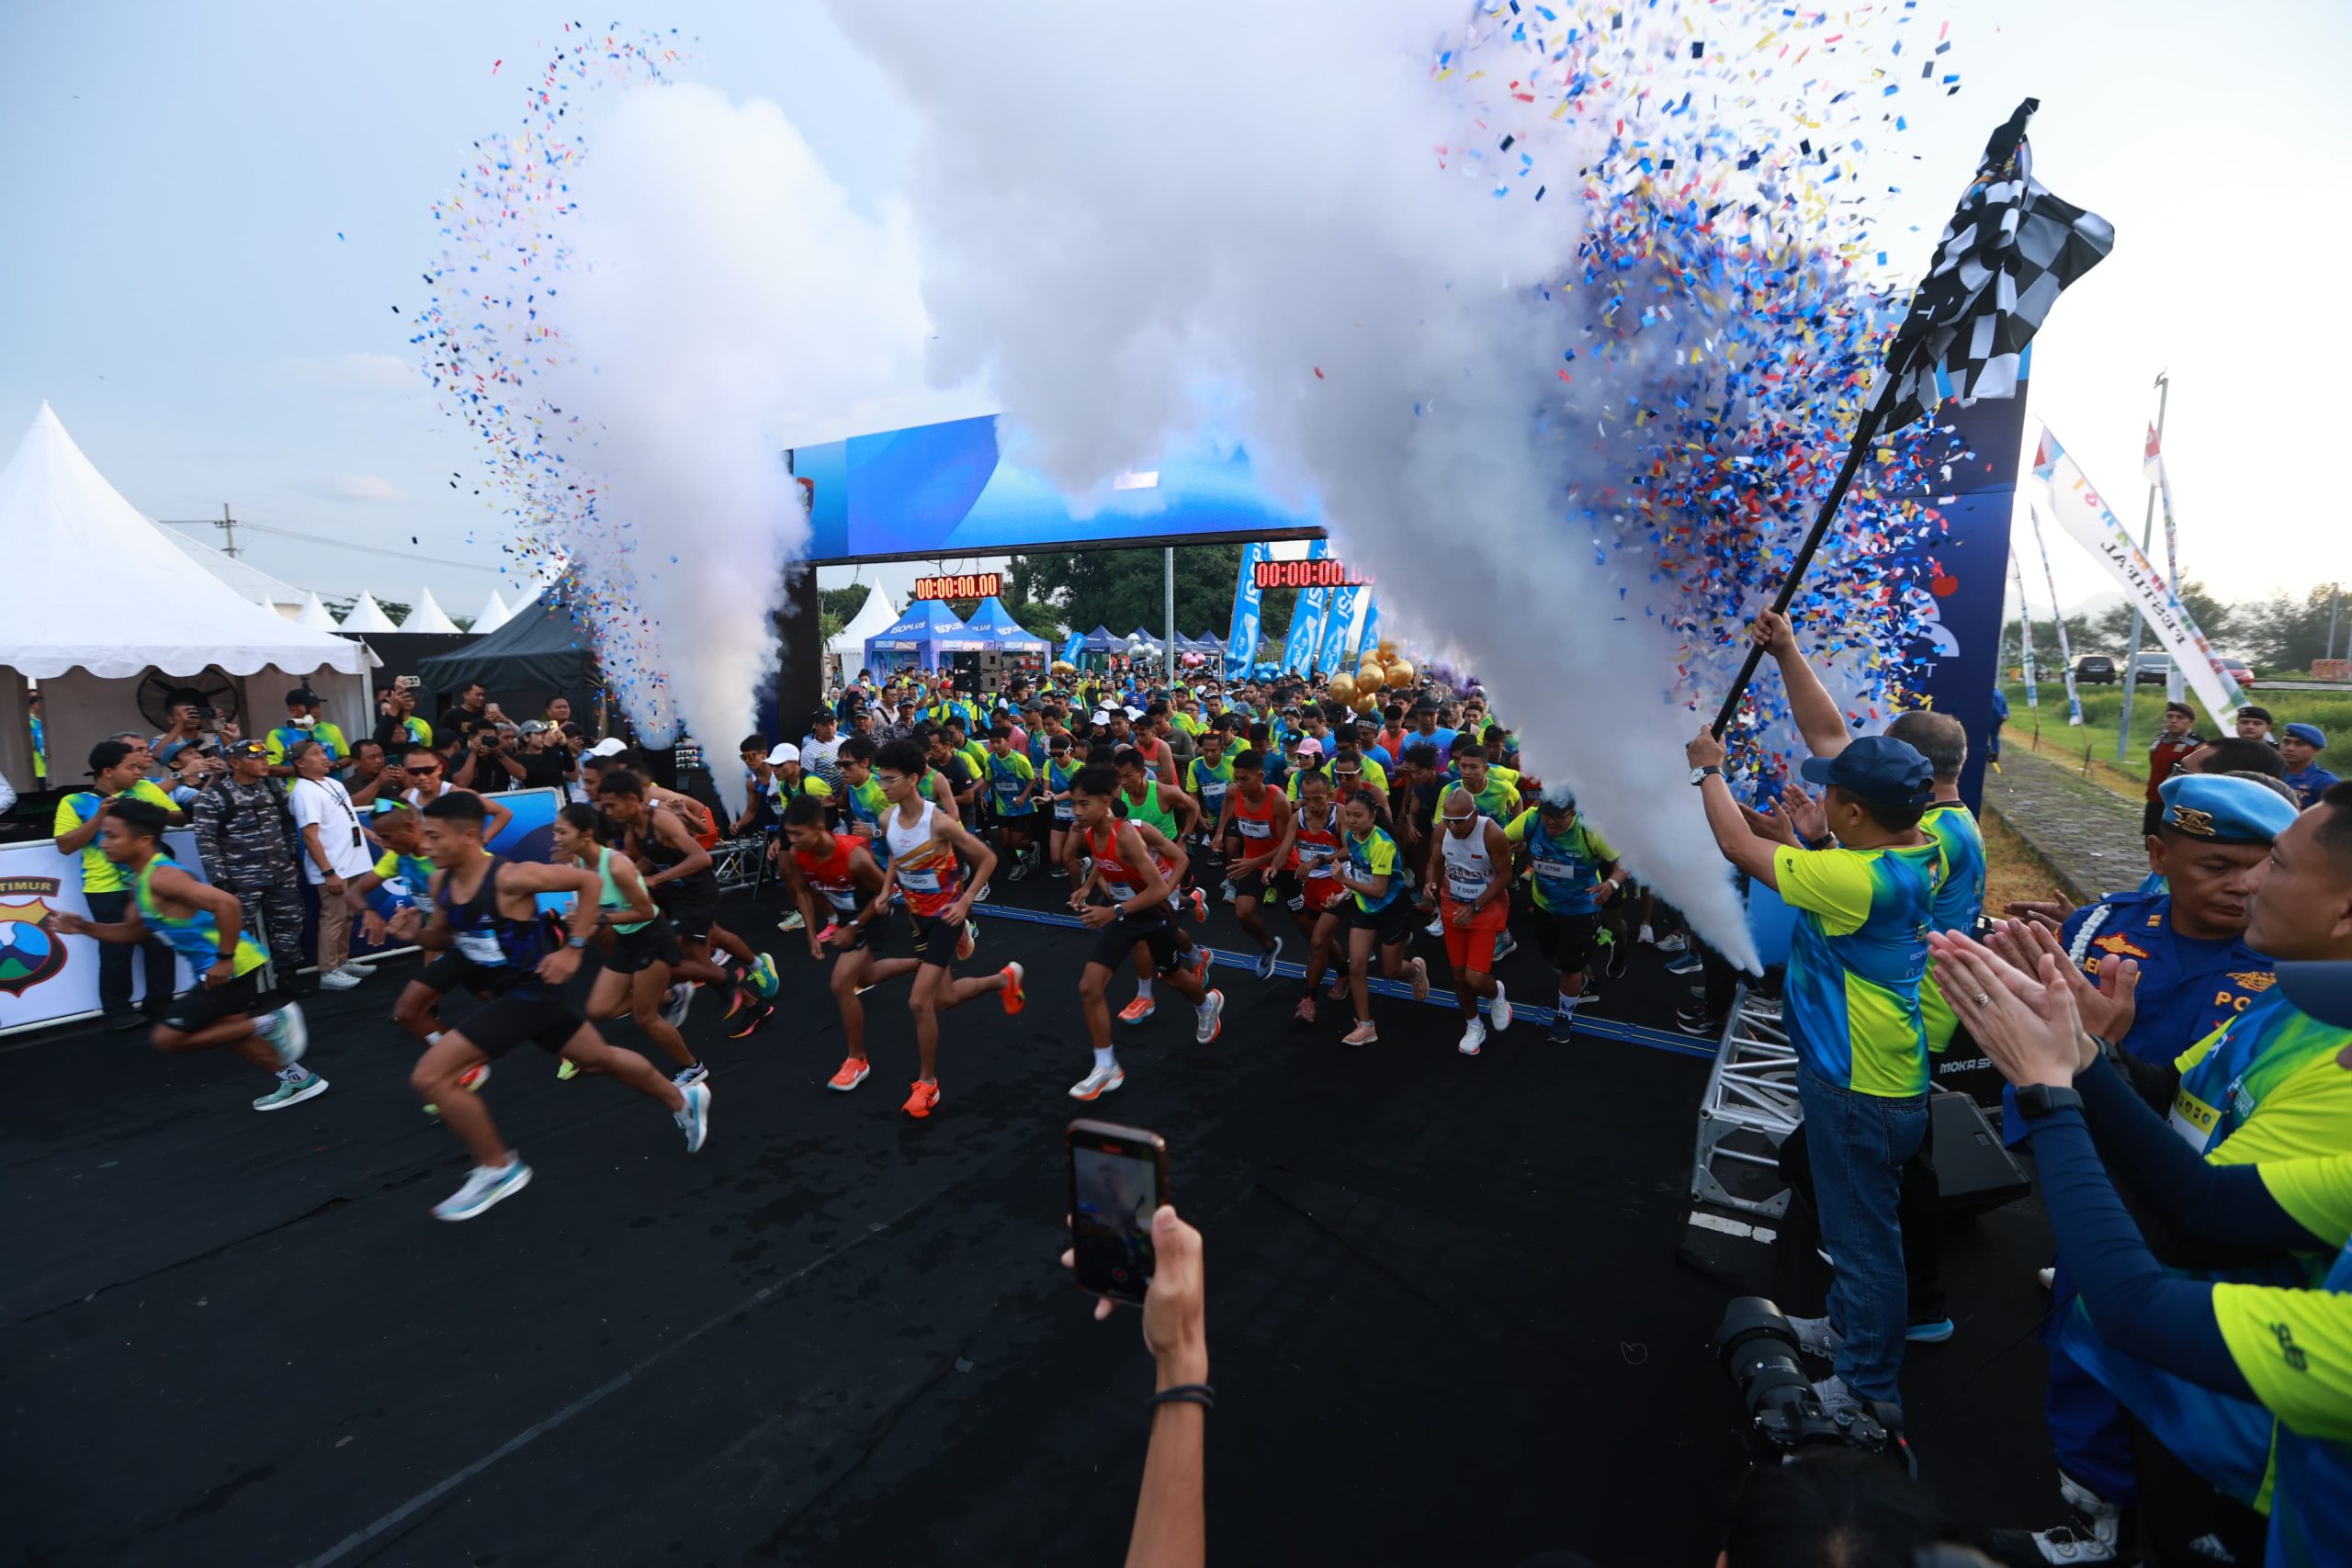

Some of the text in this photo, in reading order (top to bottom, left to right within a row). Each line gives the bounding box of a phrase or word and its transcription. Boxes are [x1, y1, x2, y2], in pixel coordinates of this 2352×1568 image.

[917, 574, 998, 600] 00:00:00.00
[889, 621, 926, 635] ISOPLUS
[0, 881, 52, 891] TIMUR
